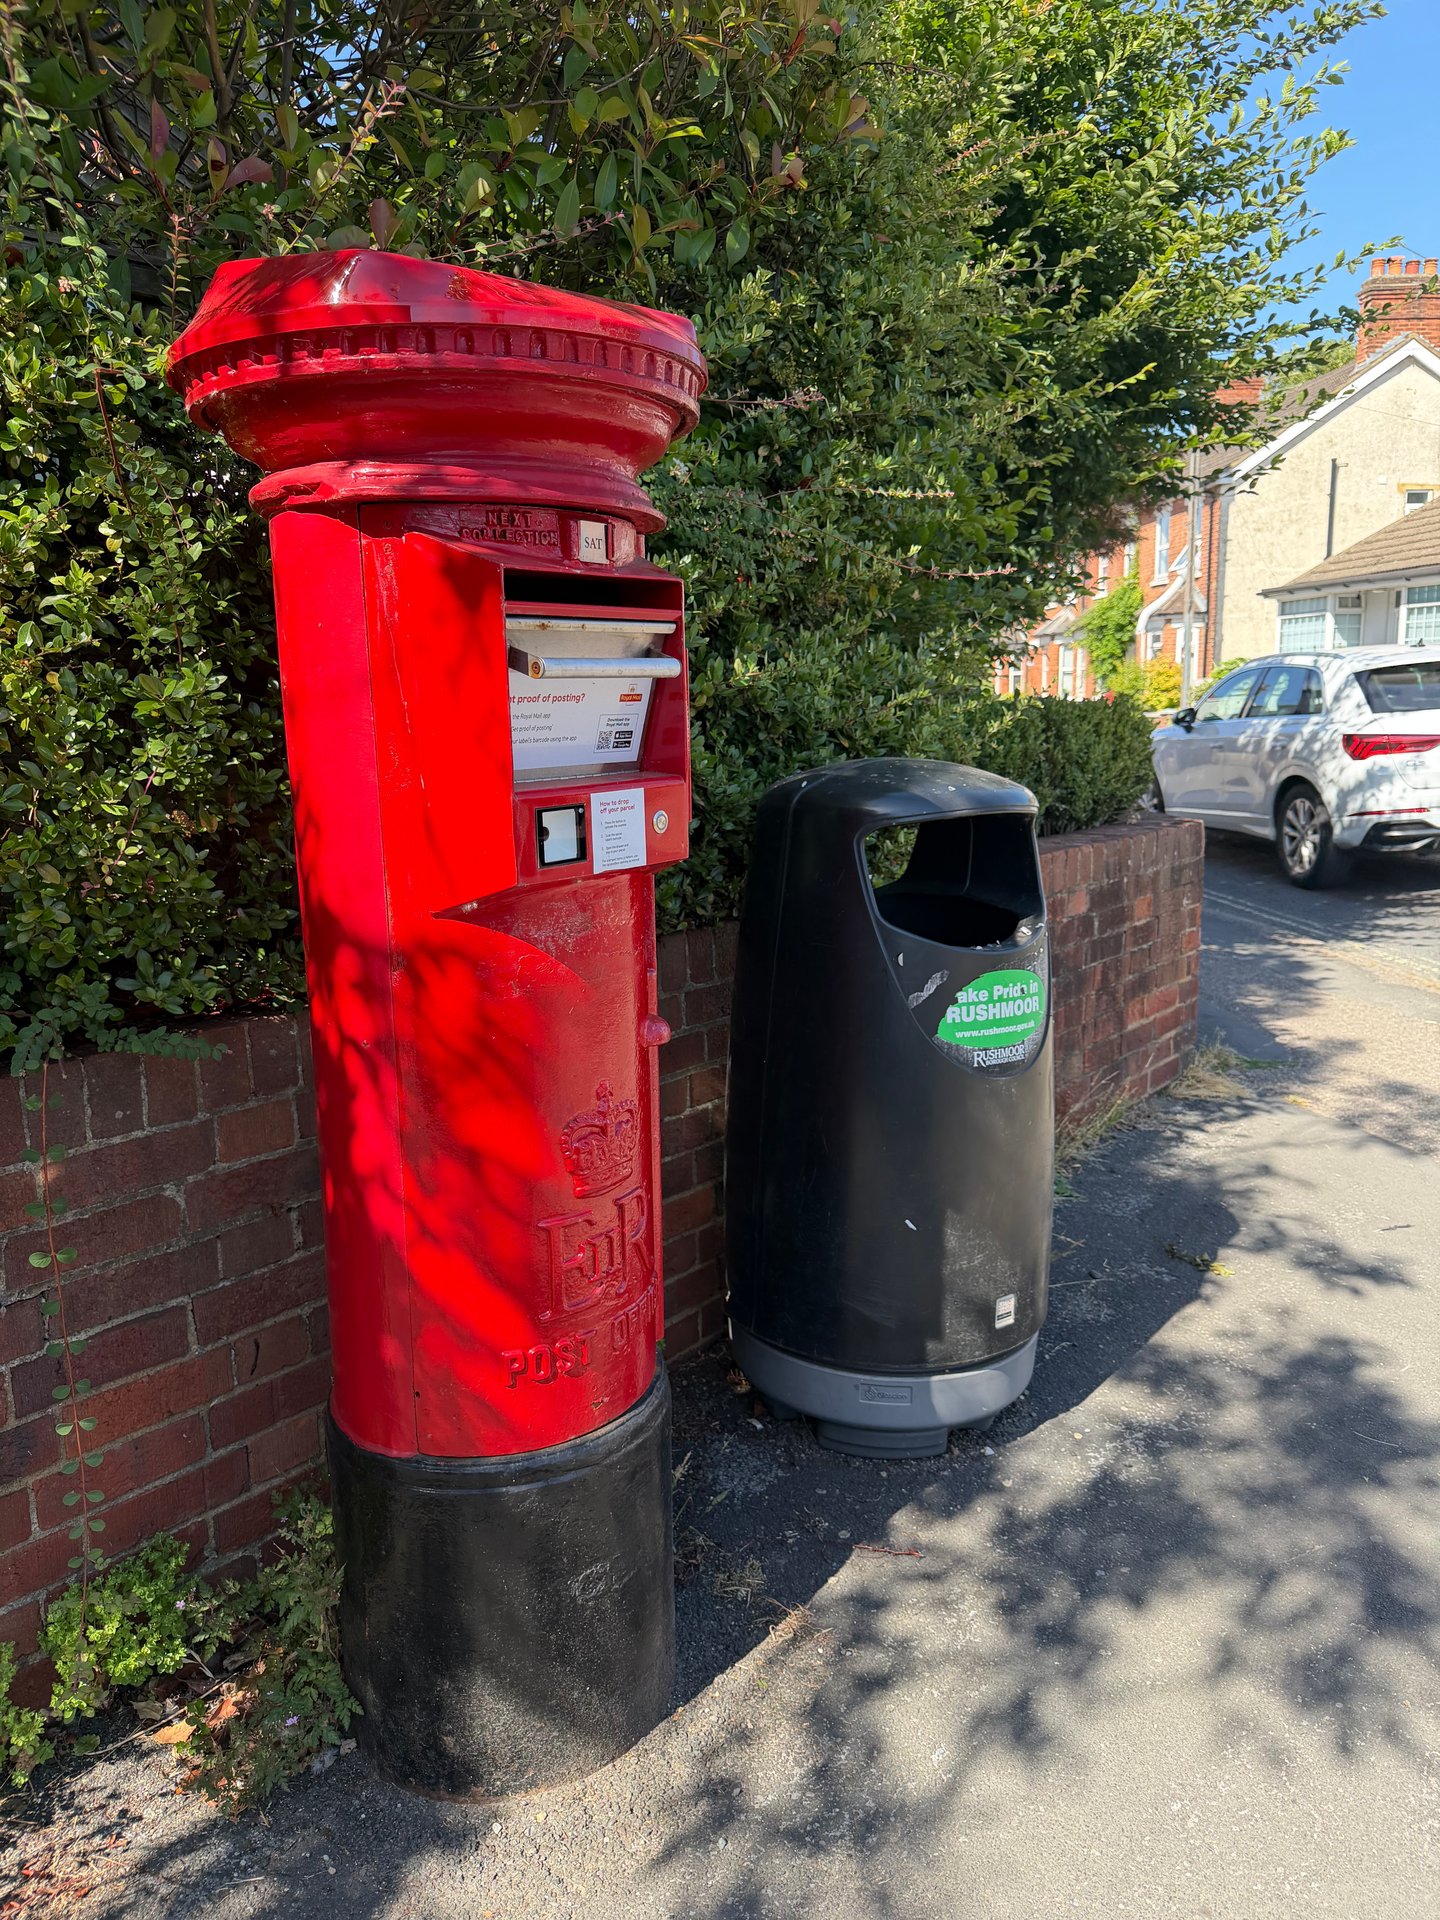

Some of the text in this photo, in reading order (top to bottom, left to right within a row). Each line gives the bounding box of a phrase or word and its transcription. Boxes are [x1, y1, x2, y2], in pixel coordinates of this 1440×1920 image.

[487, 511, 533, 526] NEXT
[461, 527, 559, 545] COLLECTION
[584, 536, 603, 550] SAT
[517, 693, 541, 705] proof
[541, 693, 552, 703] of
[552, 692, 586, 705] posting?
[620, 804, 636, 812] parcel
[956, 979, 1039, 1004] ake Pride in
[946, 996, 1040, 1023] RUSHMOOR
[955, 1019, 1035, 1038] www.rushmoor.gov.uk
[973, 1044, 1025, 1068] RUSHMOOR
[502, 1328, 598, 1389] POST
